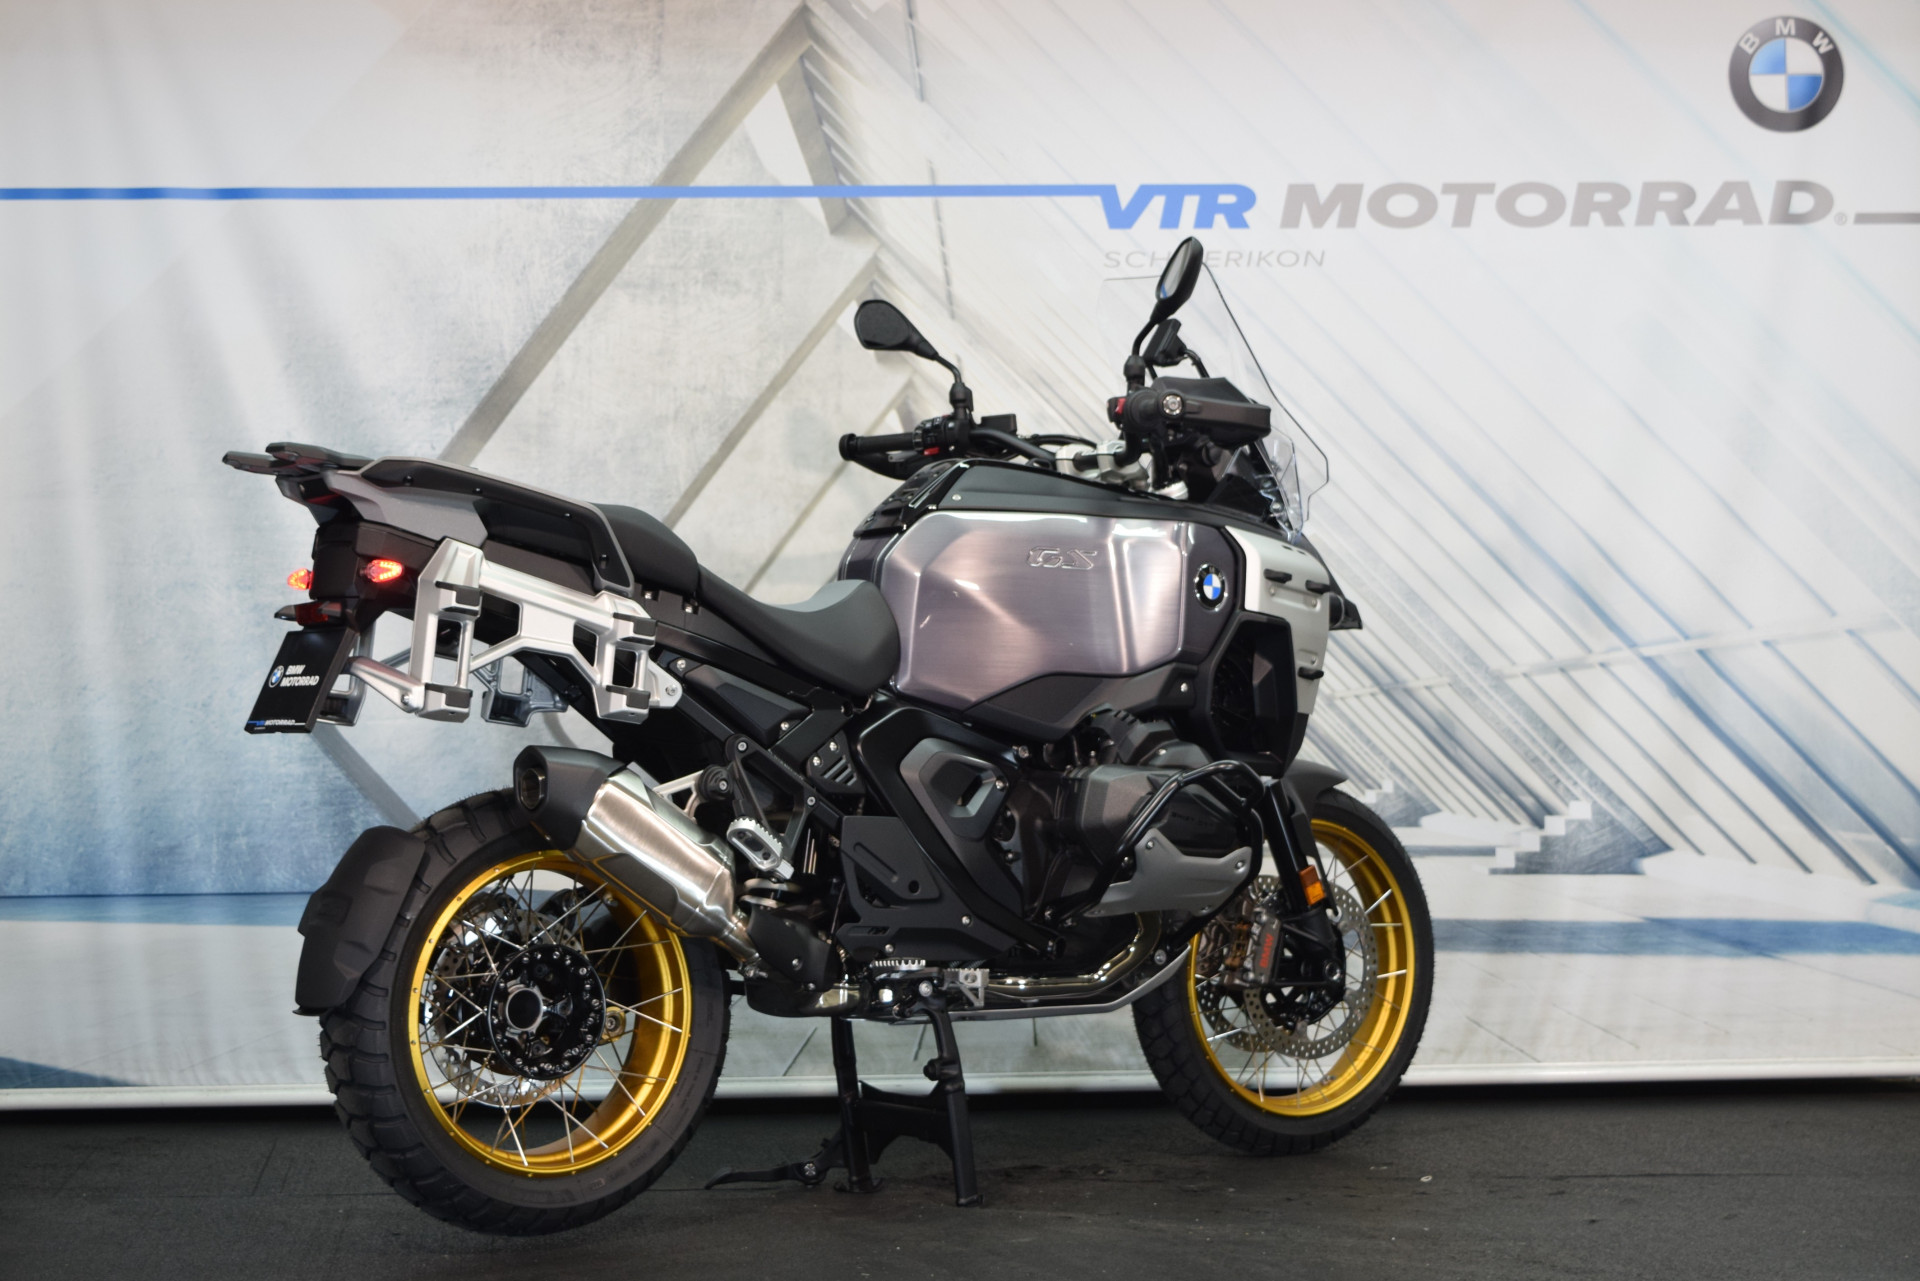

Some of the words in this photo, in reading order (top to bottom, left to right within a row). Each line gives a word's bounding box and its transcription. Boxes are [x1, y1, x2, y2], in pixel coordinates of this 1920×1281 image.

[1739, 18, 1834, 54] BMW
[1100, 184, 1256, 229] VTR
[1103, 250, 1326, 269] SCHERIKON
[1026, 545, 1098, 570] GS
[280, 676, 320, 687] MOTORRAD
[285, 664, 306, 675] BMW
[1259, 933, 1274, 968] BMW
